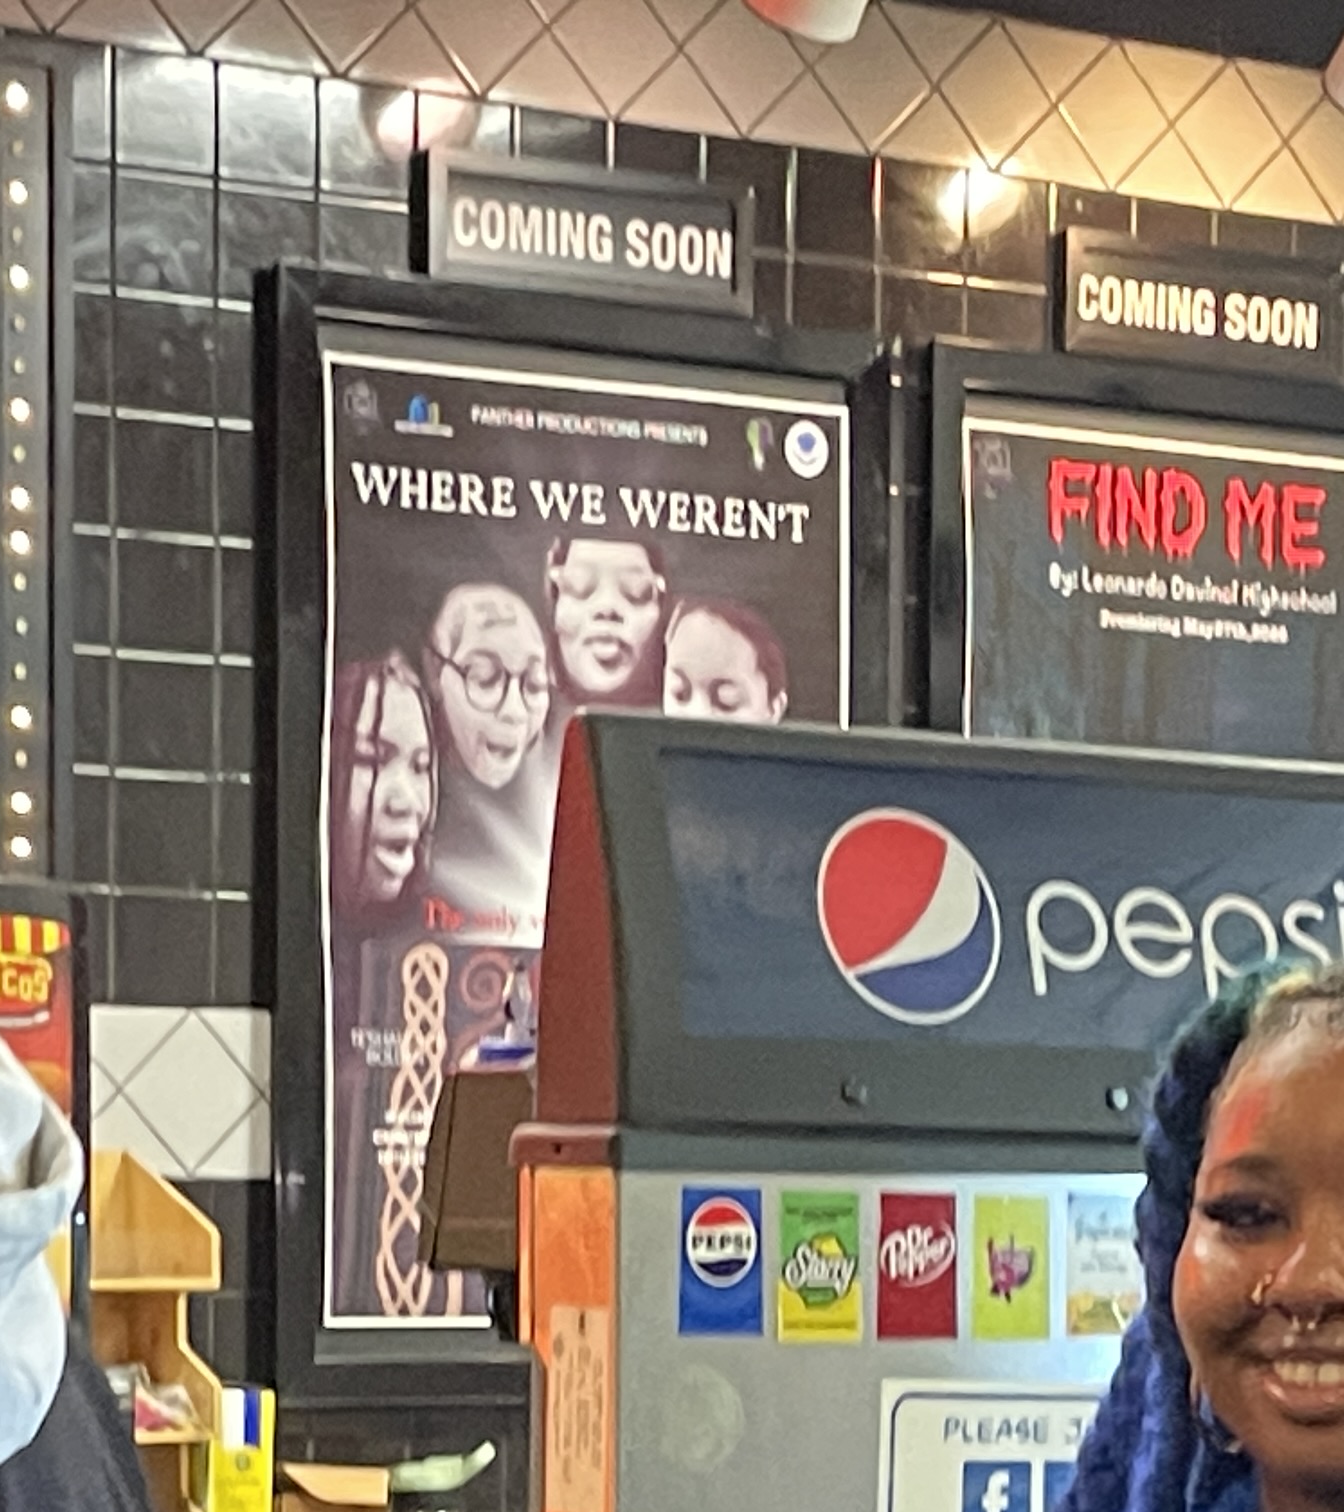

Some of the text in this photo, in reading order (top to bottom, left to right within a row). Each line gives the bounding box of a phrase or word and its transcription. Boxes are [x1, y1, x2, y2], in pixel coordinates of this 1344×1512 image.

[453, 196, 732, 280] COMING SOON
[1078, 272, 1319, 350] COMING SOON
[471, 403, 708, 448] PANTHER PRODUCTIONS PRESENTS
[351, 462, 810, 544] WHERE WE WEREN'T
[1047, 458, 1327, 574] FIND ME
[1081, 564, 1167, 600] Leonardo
[692, 1233, 752, 1254] PEPSI
[943, 1415, 1049, 1445] PLEASE
